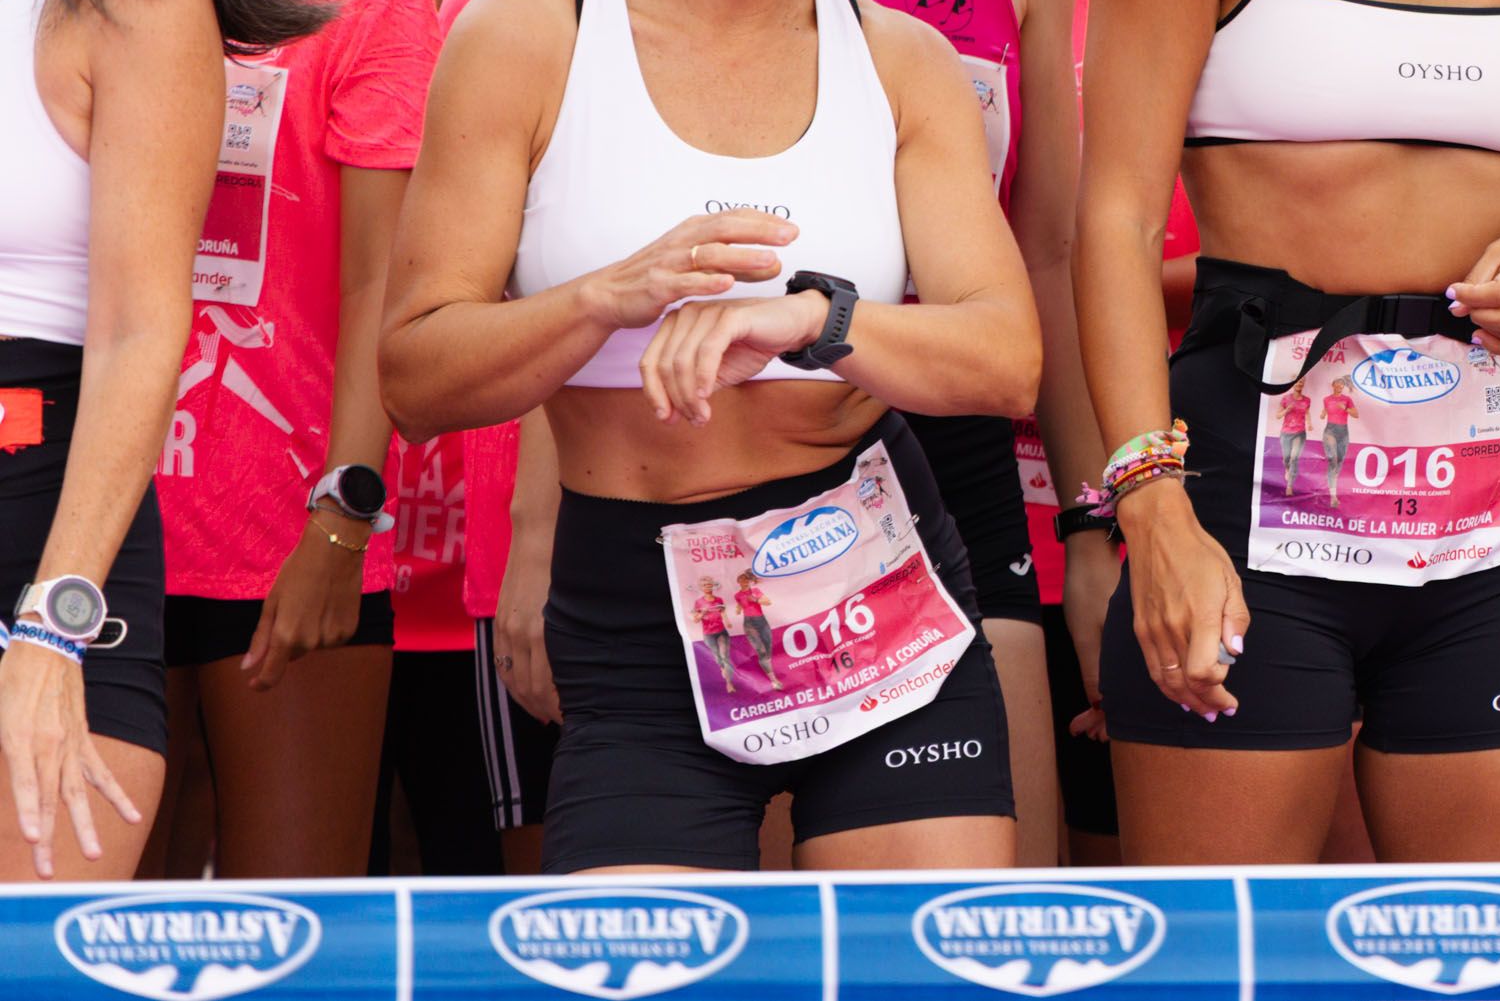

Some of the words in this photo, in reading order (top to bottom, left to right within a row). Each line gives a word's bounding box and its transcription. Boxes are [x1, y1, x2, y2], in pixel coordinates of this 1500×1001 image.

[1398, 62, 1483, 82] OYSHO
[196, 239, 239, 256] ORUÑA
[192, 272, 233, 287] ander
[1361, 365, 1454, 389] ASTURIANA
[1354, 446, 1456, 489] 016
[1394, 498, 1418, 516] 13
[1282, 511, 1345, 529] CARRERA
[1348, 519, 1365, 532] DE
[1370, 521, 1387, 534] LA
[1391, 521, 1437, 535] MUJER
[1445, 521, 1453, 533] A
[763, 522, 855, 573] ASTURIANA
[1284, 540, 1373, 565] OYSHO
[1426, 544, 1493, 567] Santander
[782, 593, 875, 658] 016
[730, 695, 794, 722] CARRERA
[796, 688, 815, 705] DE
[816, 685, 835, 701] LA
[836, 668, 880, 695] MUJER
[886, 657, 897, 672] A
[895, 628, 945, 664] CORUÑA
[831, 651, 855, 673] 16
[879, 658, 956, 704] Santander
[743, 716, 830, 753] OYSHO
[885, 740, 982, 768] OYSHO
[77, 911, 300, 957] ASTURIANA
[509, 908, 726, 954] ASTURIANA
[931, 906, 1145, 952] ASTURIANA
